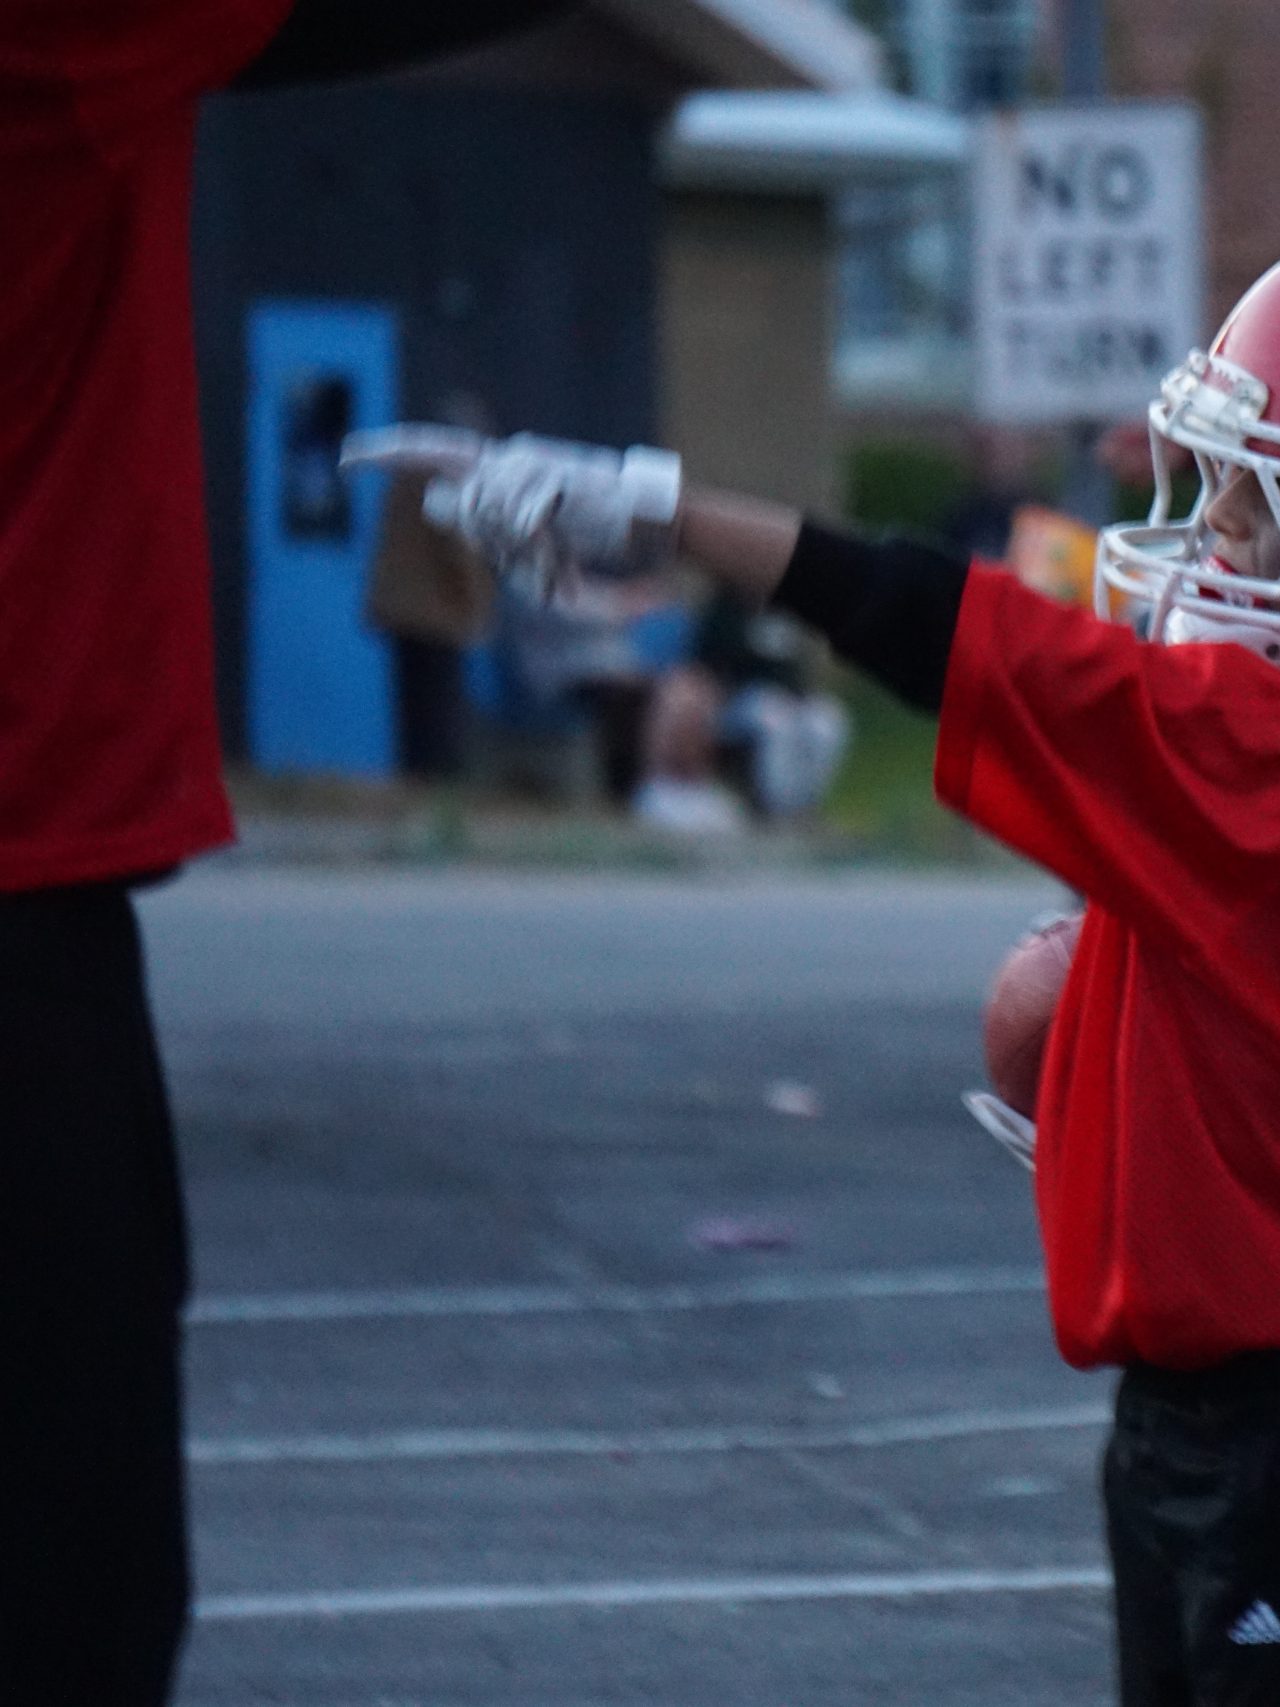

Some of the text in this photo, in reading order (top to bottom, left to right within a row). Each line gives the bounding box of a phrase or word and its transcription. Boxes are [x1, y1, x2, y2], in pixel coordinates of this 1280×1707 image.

[1016, 145, 1153, 222] NO
[998, 240, 1168, 297] LEFT
[1003, 318, 1170, 377] TURN
